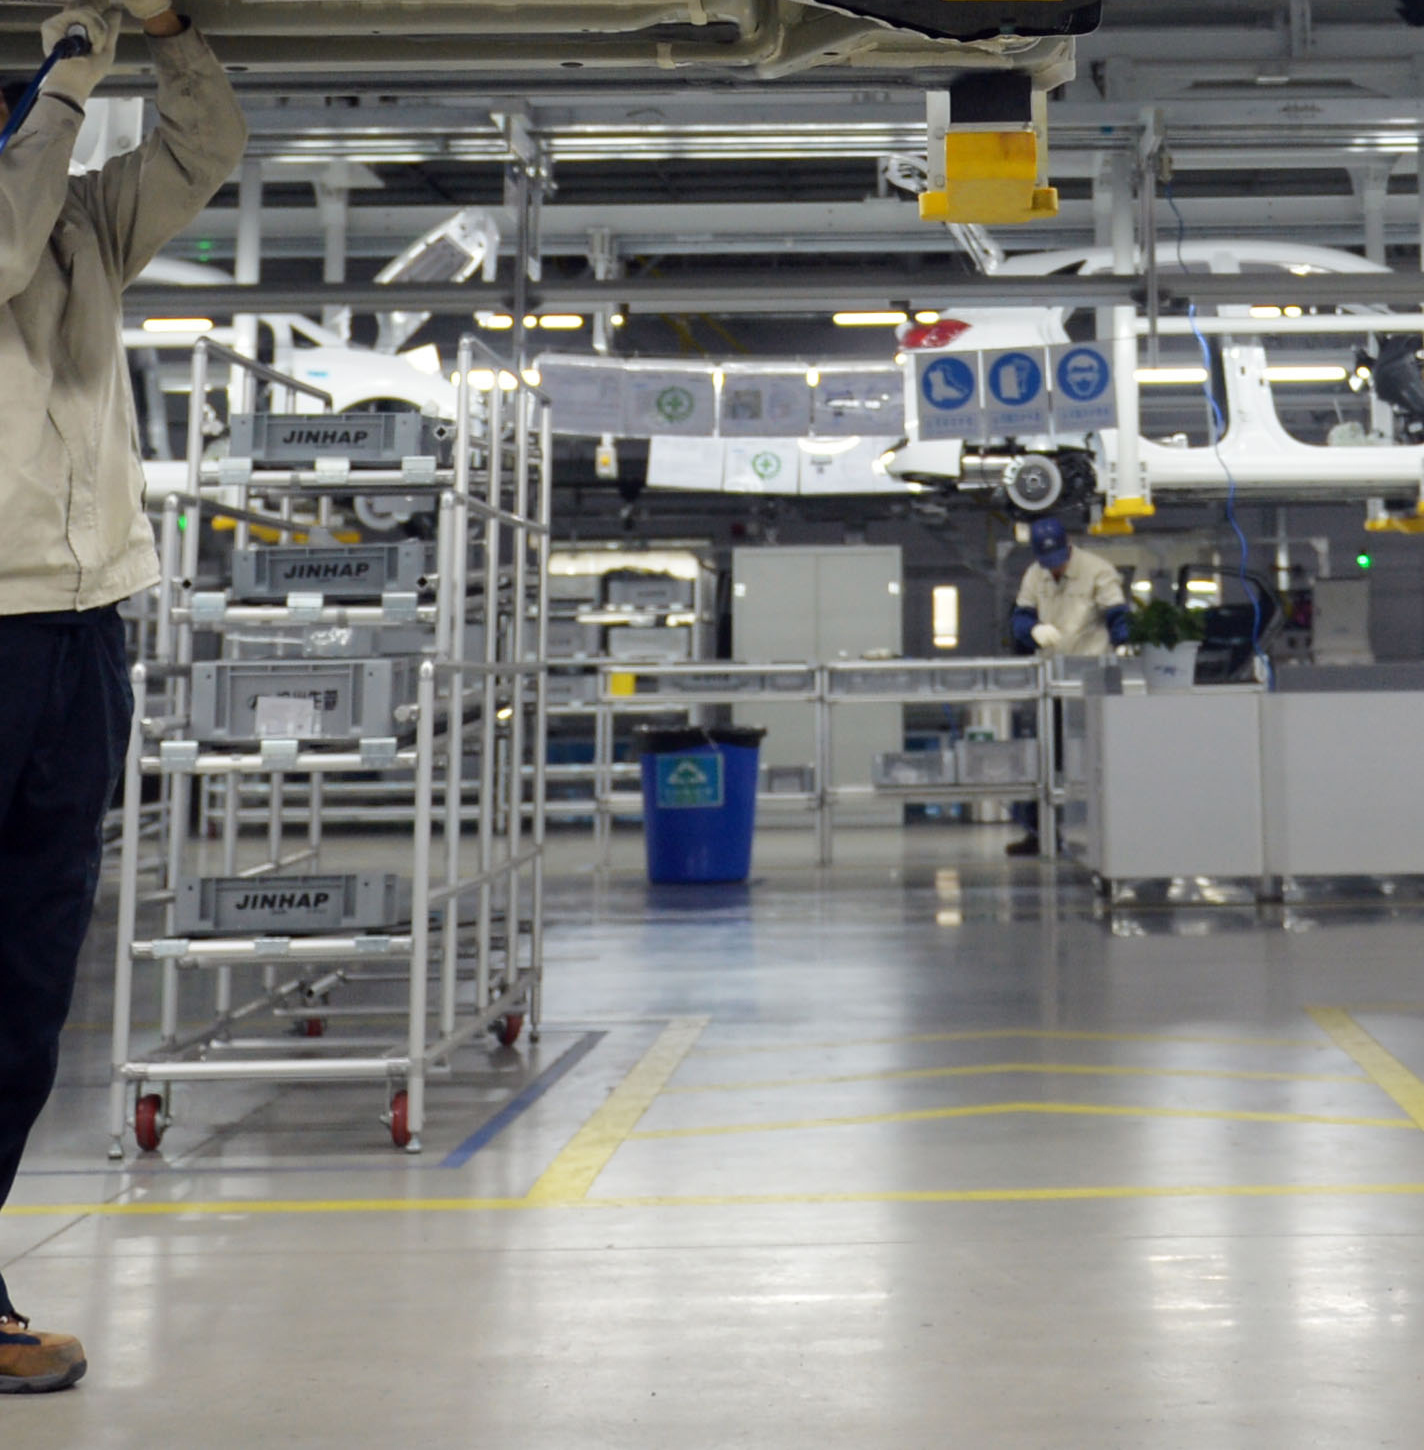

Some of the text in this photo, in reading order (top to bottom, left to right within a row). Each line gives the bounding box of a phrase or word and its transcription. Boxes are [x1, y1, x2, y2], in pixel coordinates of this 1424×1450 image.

[282, 430, 368, 444] JINHAP
[283, 562, 370, 579] JINHAP
[235, 892, 329, 910] JINHAP
